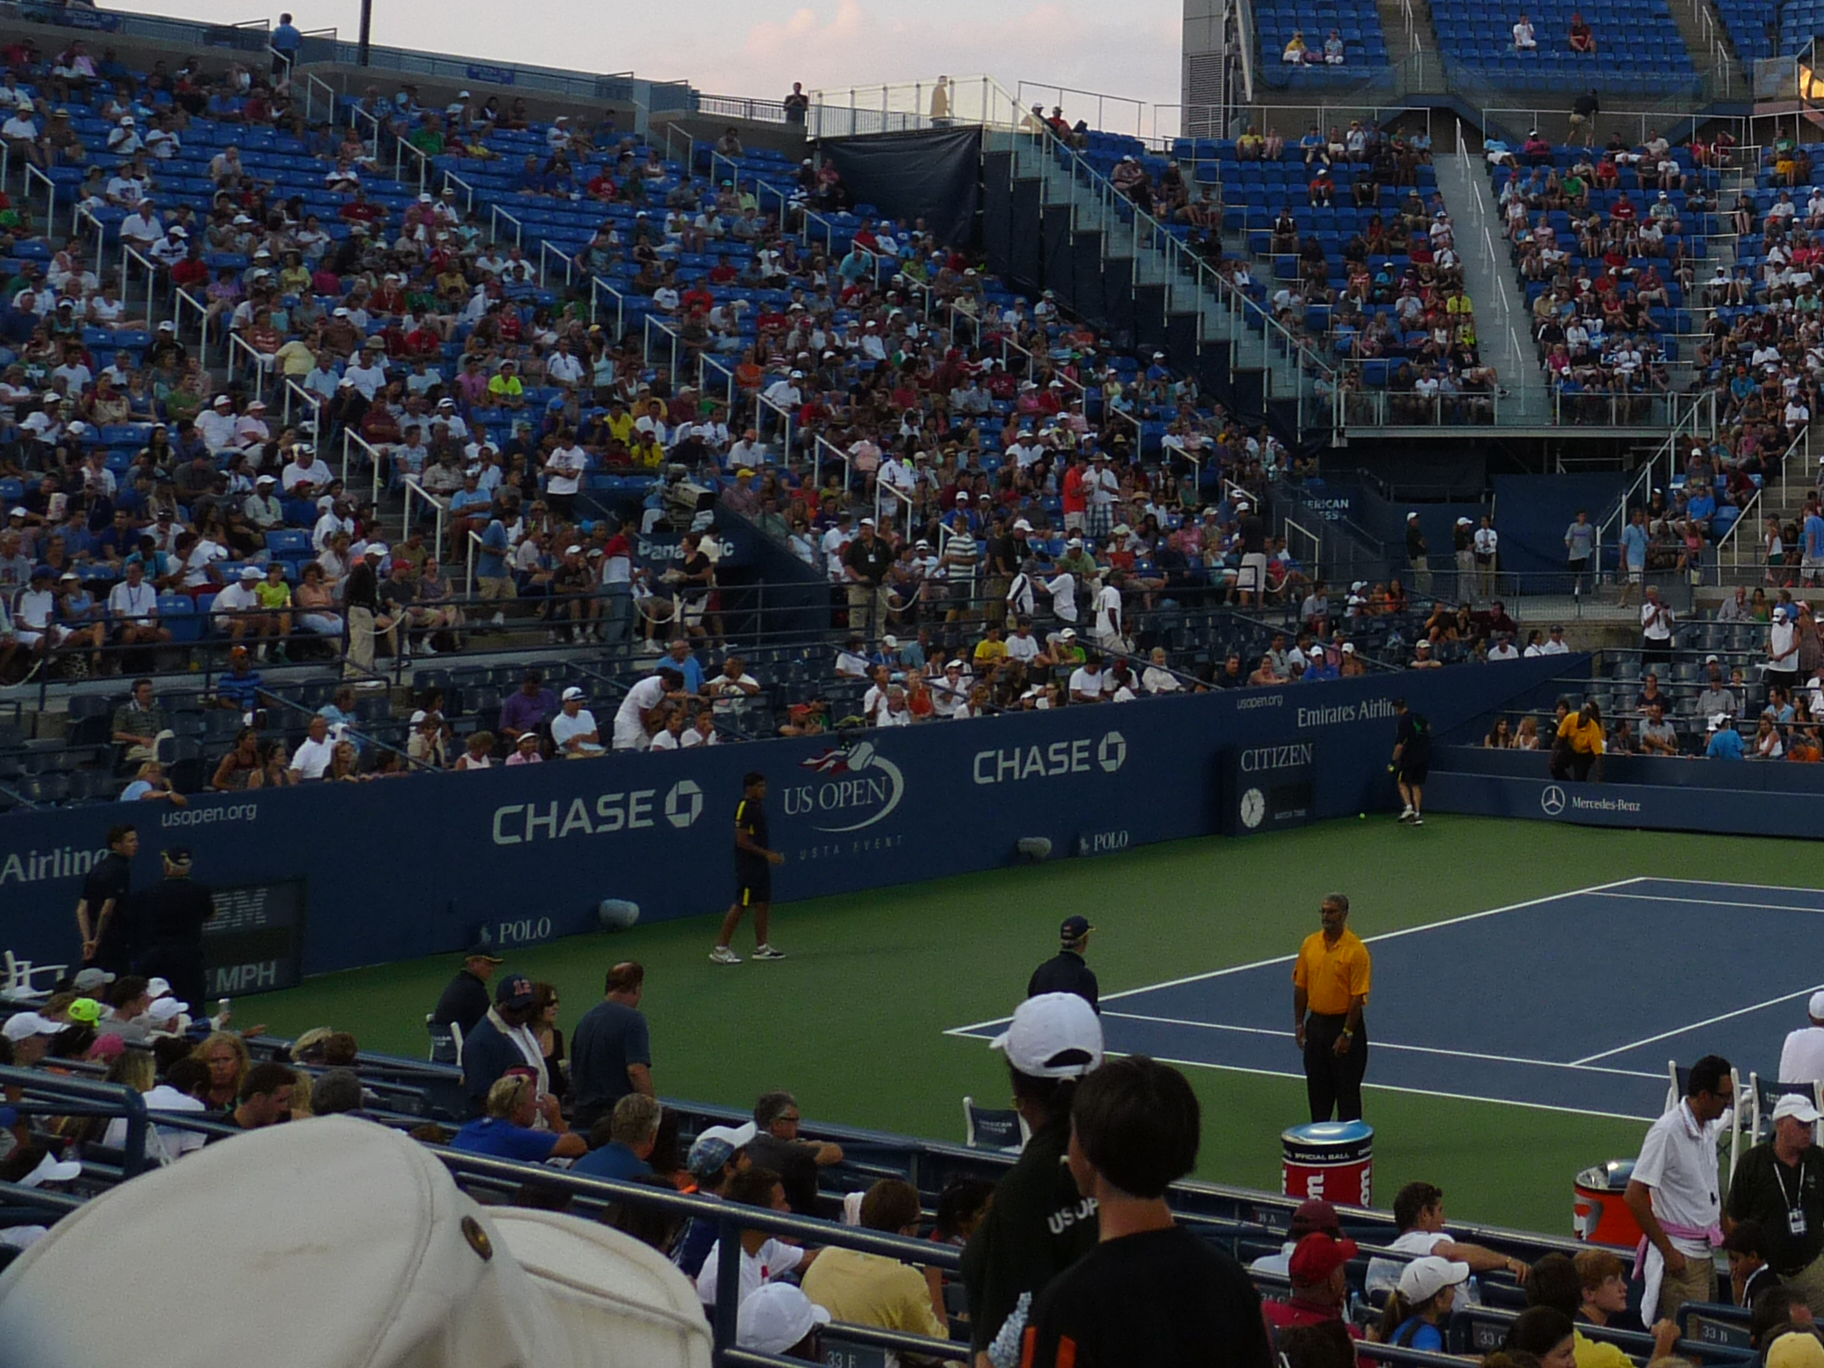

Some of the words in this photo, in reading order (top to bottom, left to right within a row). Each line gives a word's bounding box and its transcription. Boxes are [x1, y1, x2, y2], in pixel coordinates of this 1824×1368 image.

[638, 538, 734, 560] Panaic
[1237, 694, 1283, 710] usopen.org
[1298, 704, 1355, 728] Emirates
[973, 739, 1092, 785] CHASE
[1240, 742, 1313, 772] CITIZEN
[783, 786, 814, 816] US
[819, 776, 887, 811] OPEN
[1571, 796, 1641, 812] Mercedes-Benz
[161, 802, 257, 827] usopen.org
[492, 788, 657, 845] CHASE
[1093, 829, 1129, 852] POLO
[202, 888, 268, 931] BM
[499, 917, 551, 943] POLO
[216, 959, 277, 992] MPH
[1047, 1205, 1075, 1234] US
[1480, 1330, 1495, 1346] 33
[1702, 1325, 1717, 1339] 33
[827, 1350, 843, 1368] 33
